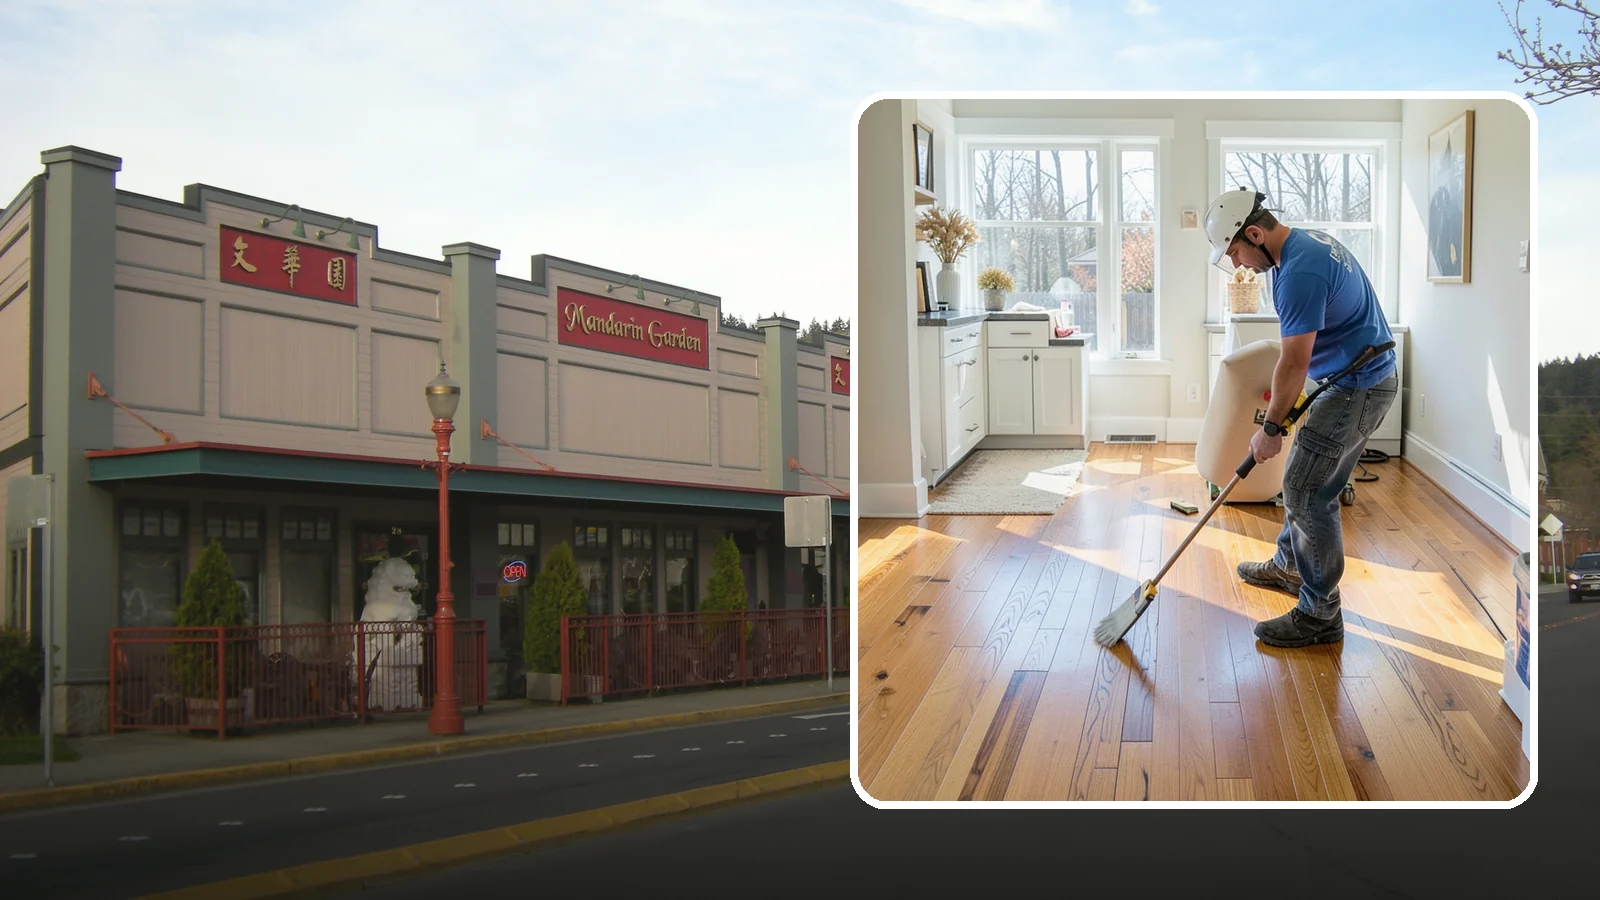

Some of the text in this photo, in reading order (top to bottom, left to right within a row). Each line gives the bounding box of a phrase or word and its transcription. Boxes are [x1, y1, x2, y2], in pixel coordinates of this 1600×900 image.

[230, 236, 346, 291] 文華園
[564, 303, 701, 352] Mandarin Garden
[835, 363, 846, 386] 文
[504, 565, 526, 577] OPEN
